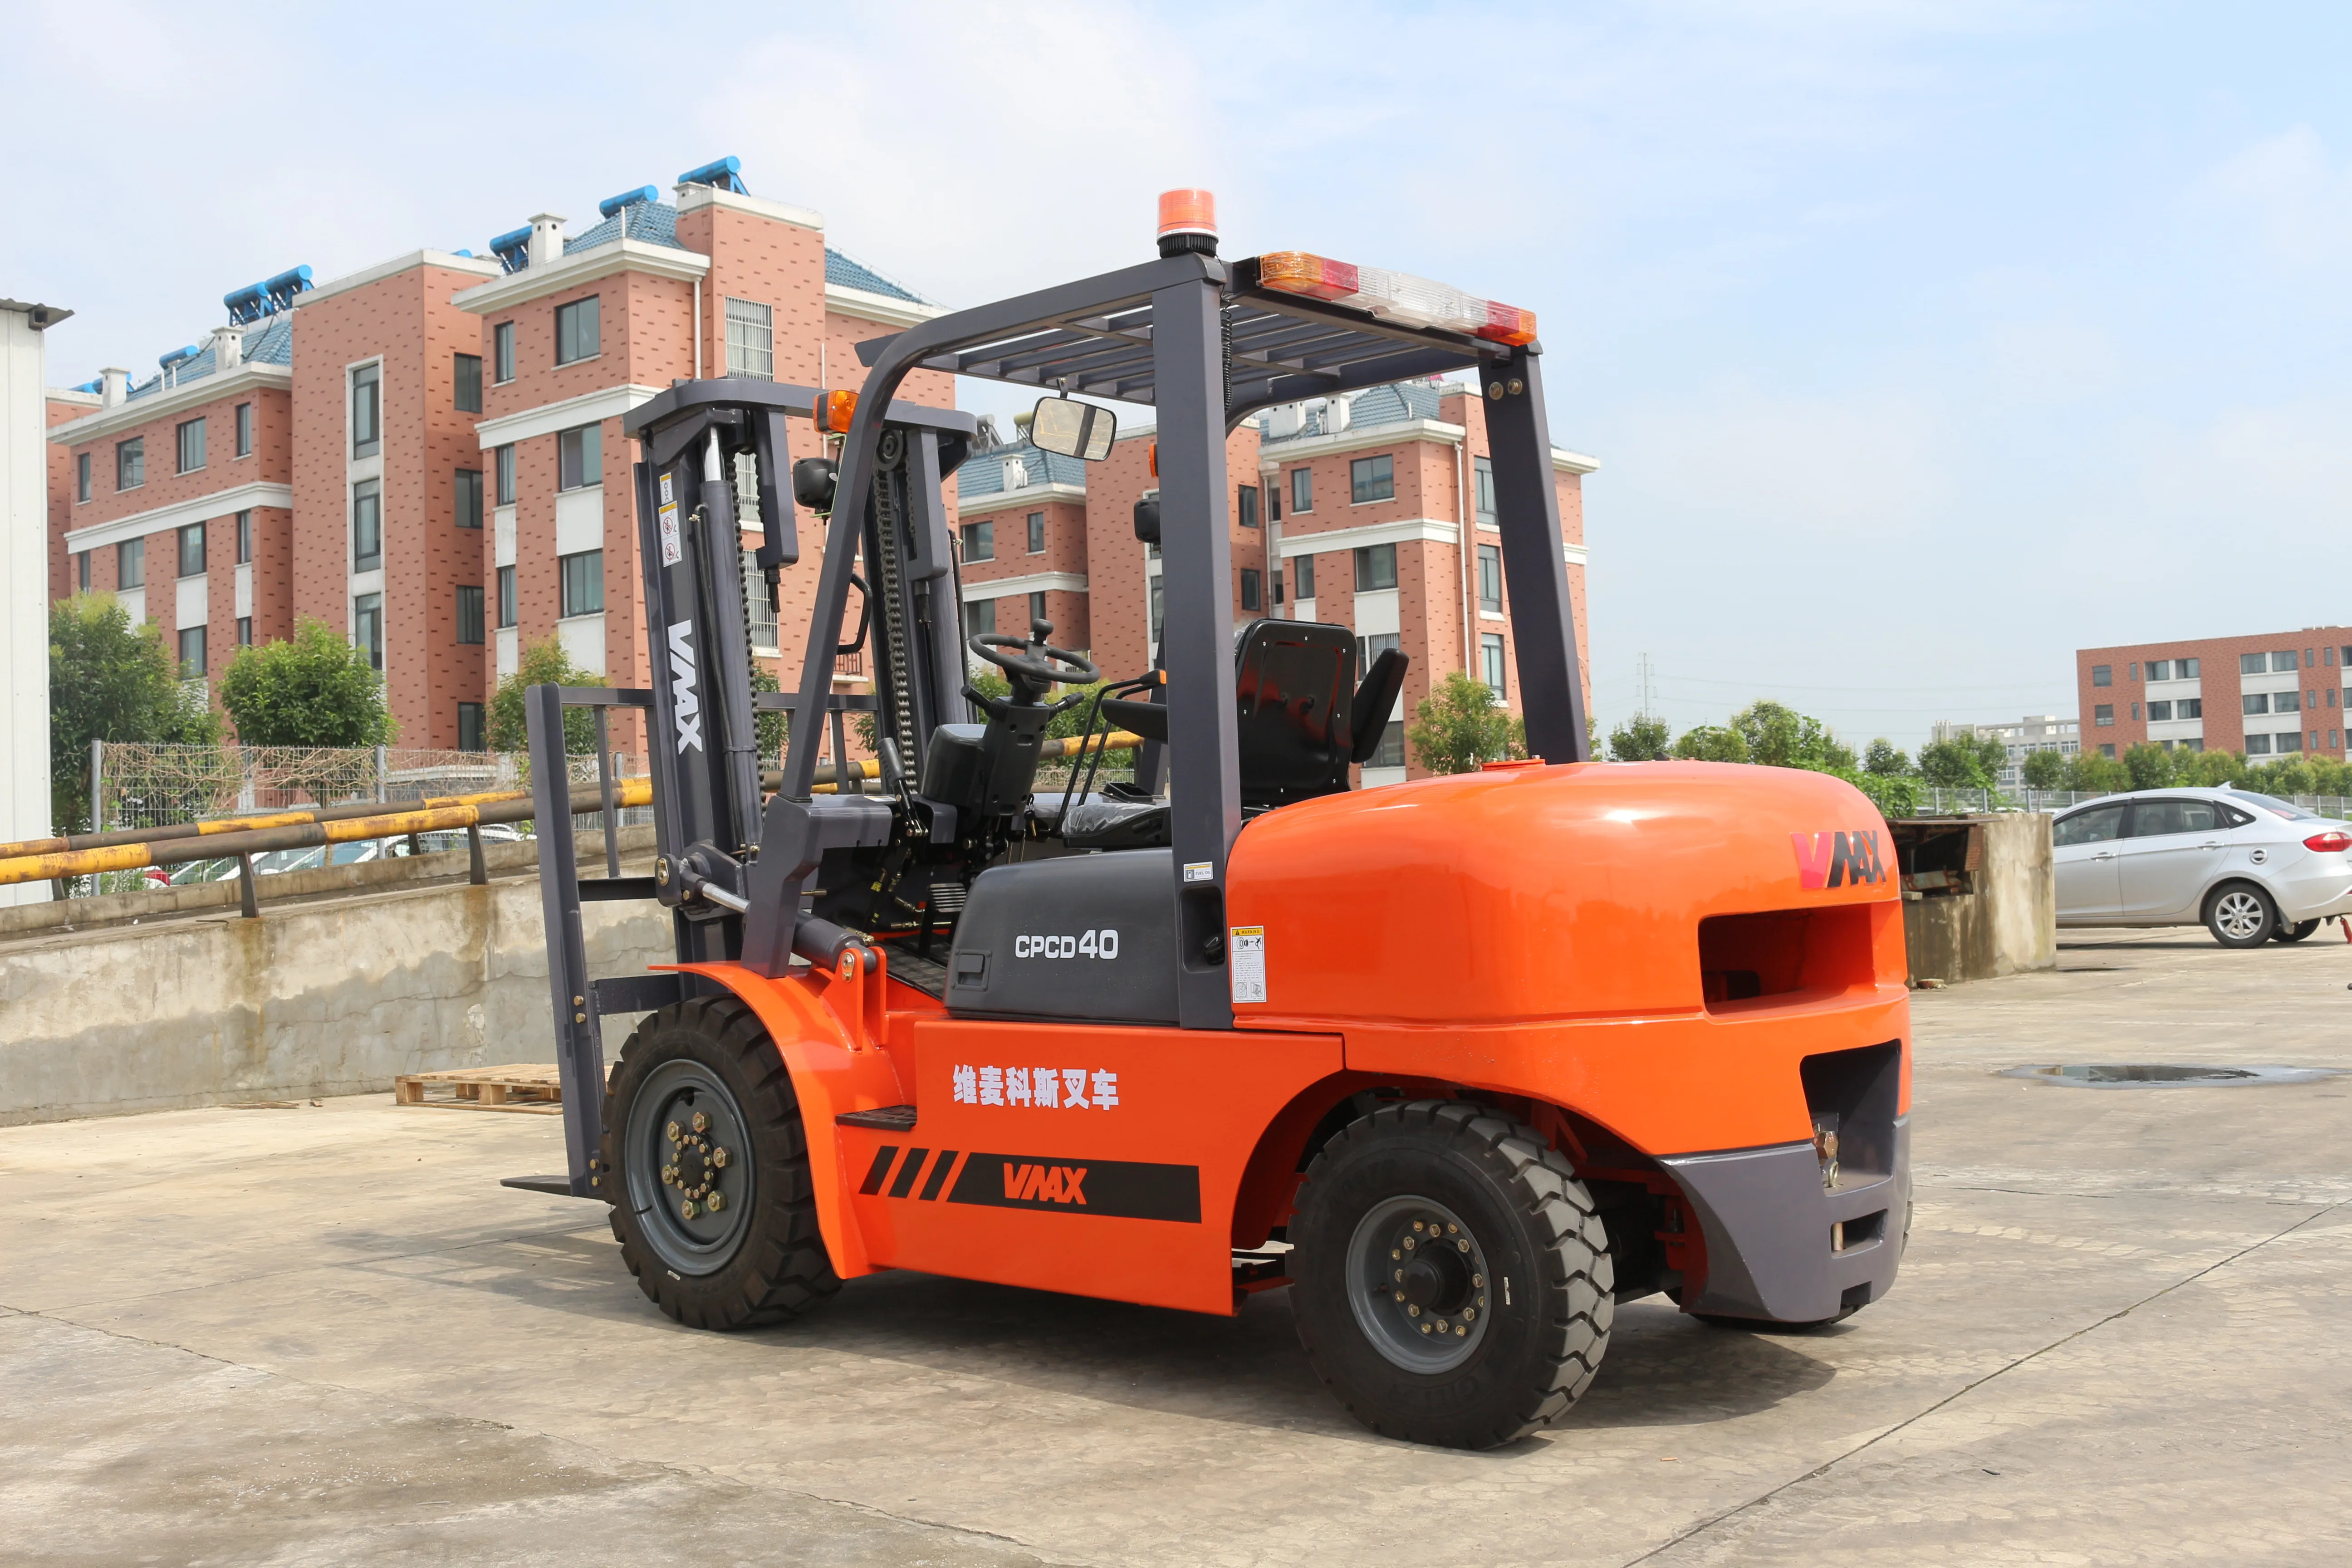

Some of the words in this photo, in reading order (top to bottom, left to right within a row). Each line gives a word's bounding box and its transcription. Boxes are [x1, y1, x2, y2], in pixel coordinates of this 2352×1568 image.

[668, 620, 703, 755] VMAX
[1790, 830, 1887, 889] VMAX
[953, 1064, 1119, 1111] 维麦科斯叉车
[1003, 1162, 1088, 1205] VMAX
